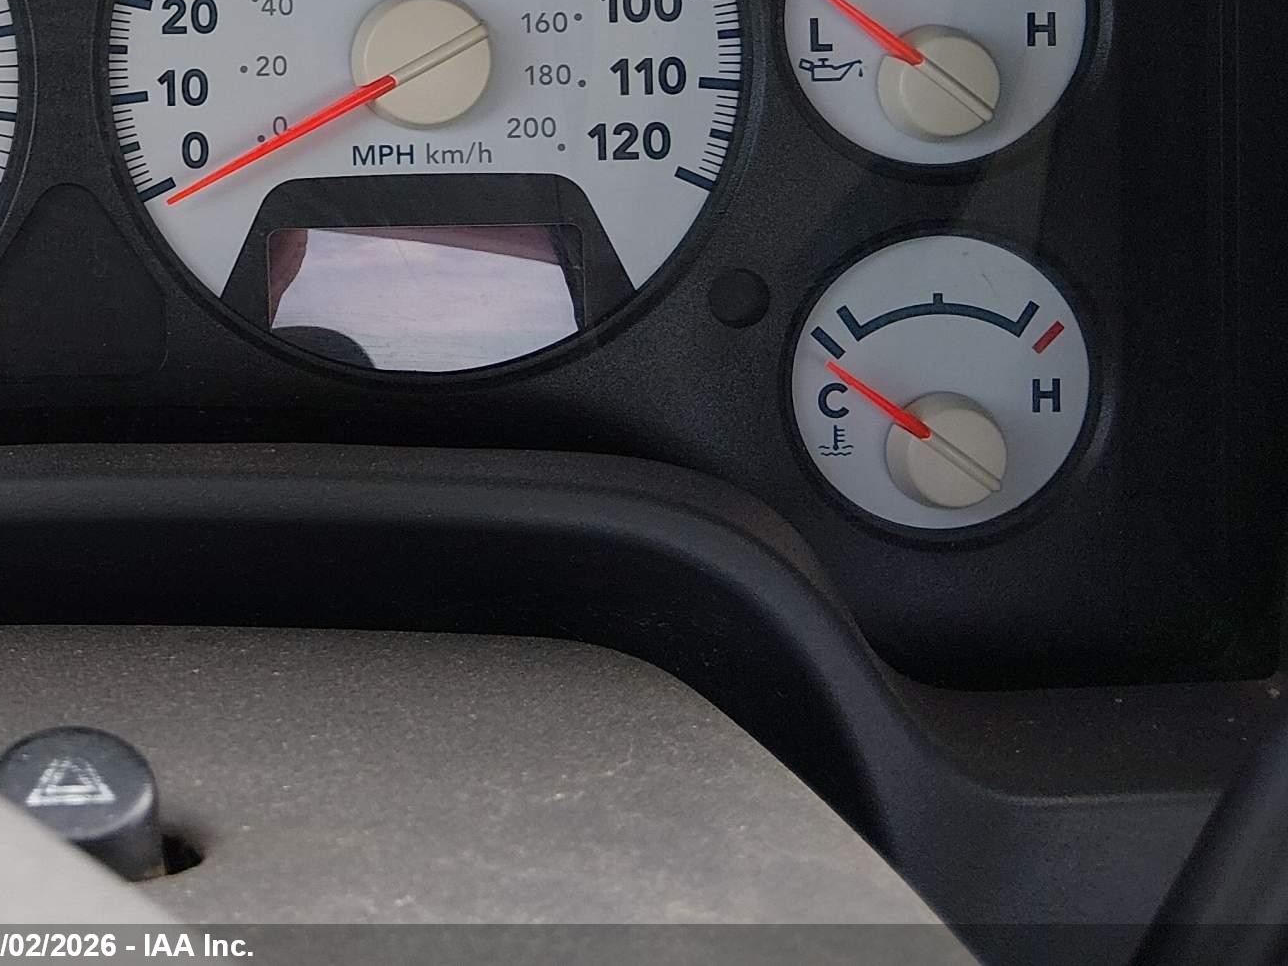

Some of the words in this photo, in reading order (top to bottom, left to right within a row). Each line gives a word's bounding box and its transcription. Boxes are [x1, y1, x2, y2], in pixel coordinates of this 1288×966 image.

[521, 11, 568, 34] 160
[809, 17, 834, 53] L
[1026, 11, 1057, 47] H
[255, 55, 287, 77] 20
[524, 64, 571, 86] 180
[609, 56, 687, 96] 110
[157, 68, 209, 107] 10
[272, 115, 288, 138] 0
[507, 116, 557, 139] 200
[587, 121, 672, 161] 120
[181, 131, 209, 170] 0
[352, 144, 414, 166] MPH
[426, 141, 493, 165] km/h
[817, 381, 850, 419] C
[1032, 377, 1061, 413] H
